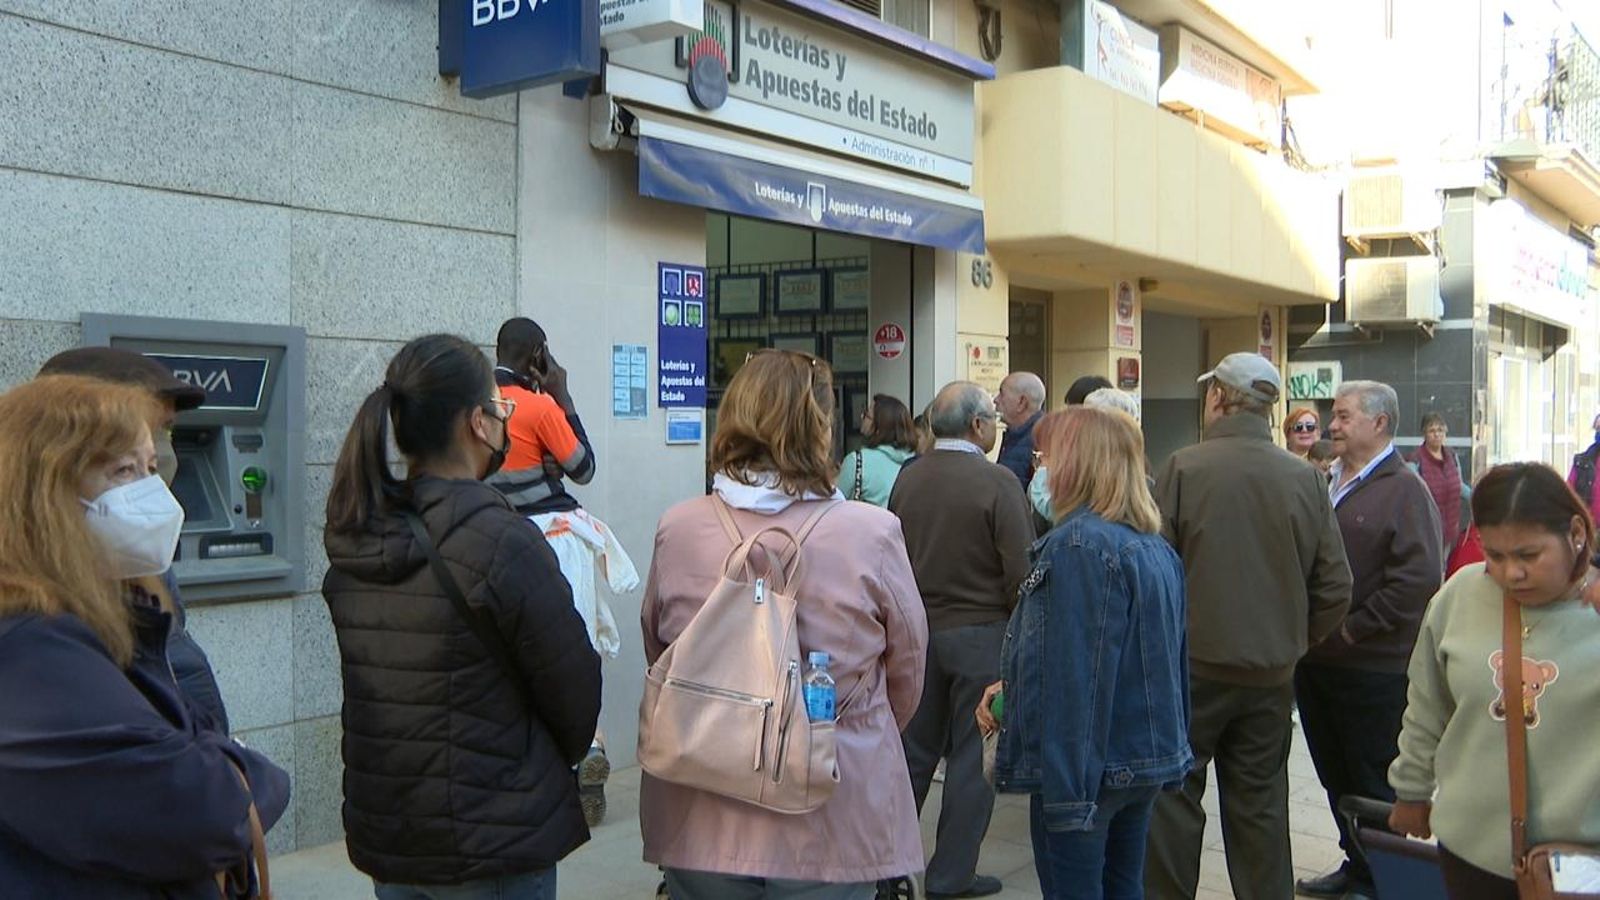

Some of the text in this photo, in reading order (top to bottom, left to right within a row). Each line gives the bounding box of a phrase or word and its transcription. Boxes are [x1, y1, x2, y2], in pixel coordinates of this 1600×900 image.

[745, 16, 847, 82] Loterías y
[745, 58, 938, 141] Apuestas del Estado
[852, 136, 917, 168] Administración
[755, 181, 912, 227] Loterías y Apuestas del Estado
[661, 360, 696, 374] Loterías y
[661, 375, 706, 389] Apuestas del
[661, 391, 686, 402] Estado
